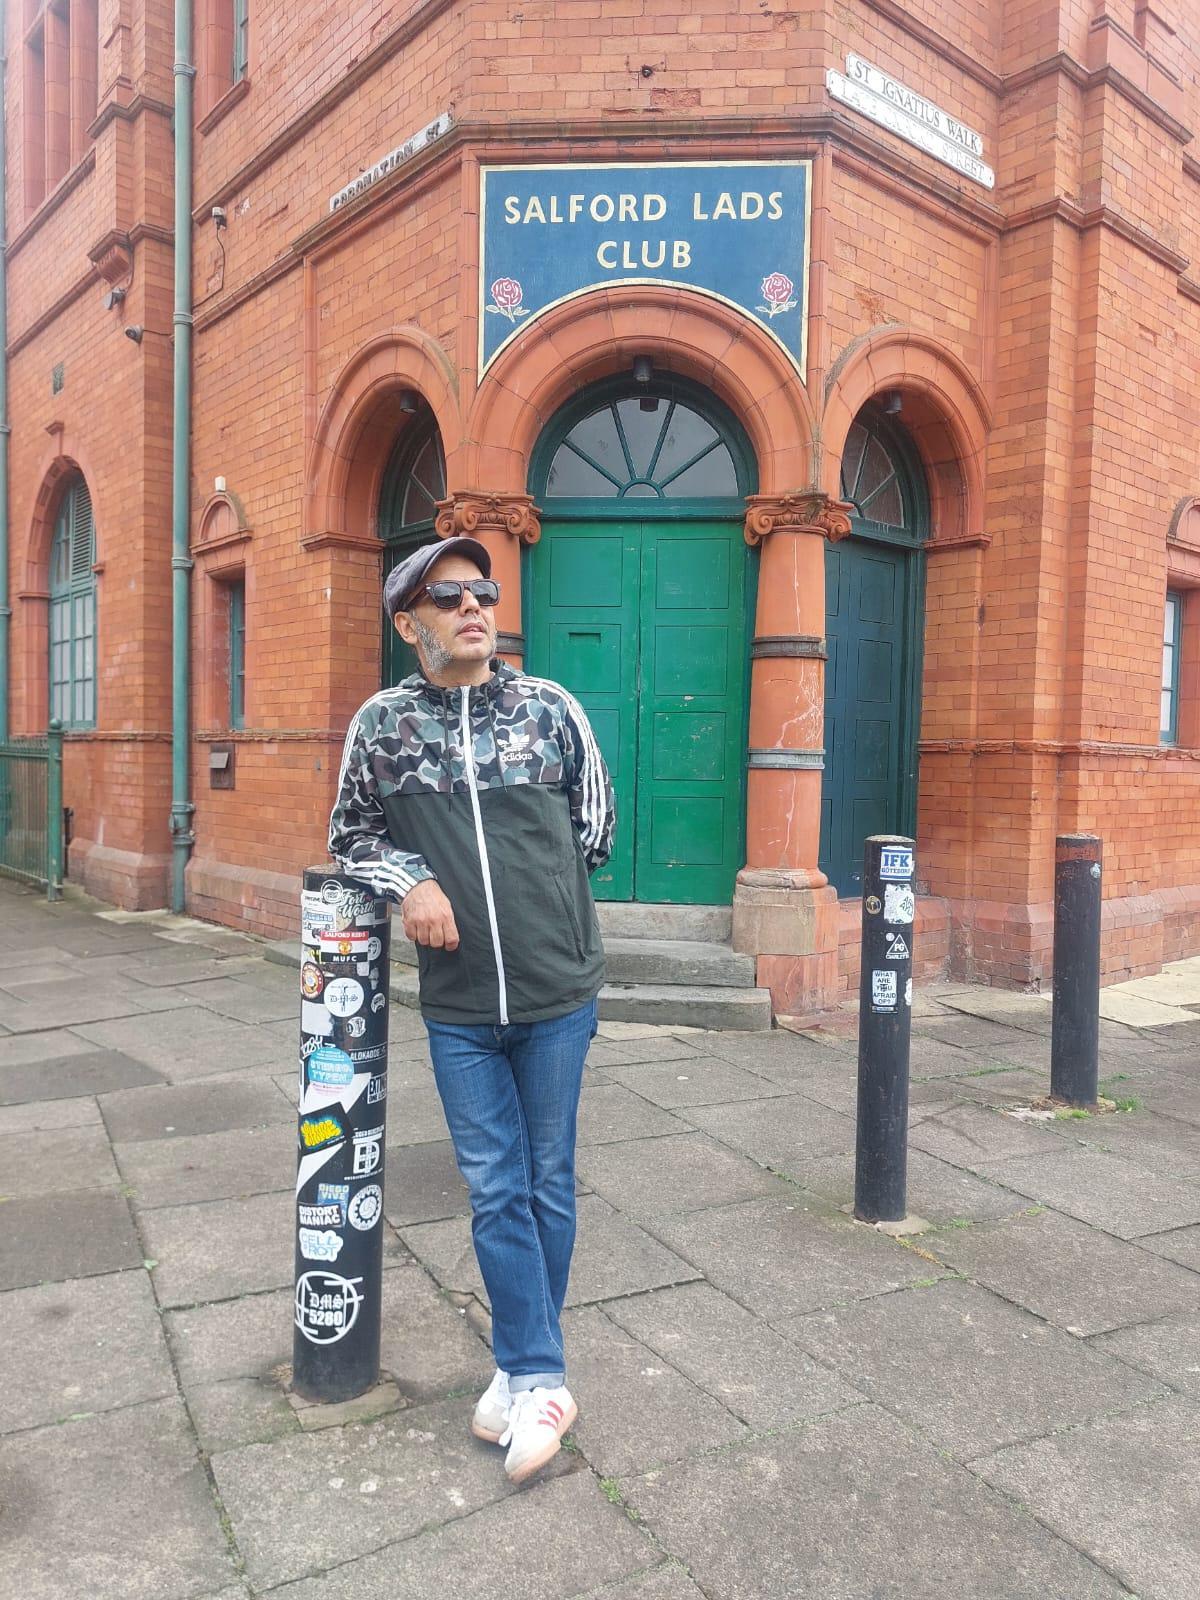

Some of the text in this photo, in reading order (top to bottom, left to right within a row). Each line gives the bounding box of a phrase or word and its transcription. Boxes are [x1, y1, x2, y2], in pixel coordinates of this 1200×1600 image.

[855, 60, 871, 83] ST
[882, 77, 940, 128] IGNATIUS
[946, 117, 979, 153] WALK
[942, 144, 984, 180] STREET
[505, 192, 782, 224] SALFORD LADS
[597, 241, 691, 268] CLUB
[501, 752, 533, 761] adidas
[883, 854, 910, 867] IFK
[339, 889, 365, 905] Fort
[339, 901, 376, 918] Worth
[321, 1191, 345, 1199] VIVE
[299, 1205, 339, 1217] DISTORT
[300, 1215, 340, 1226] MANIAC
[309, 1309, 343, 1326] 5280
